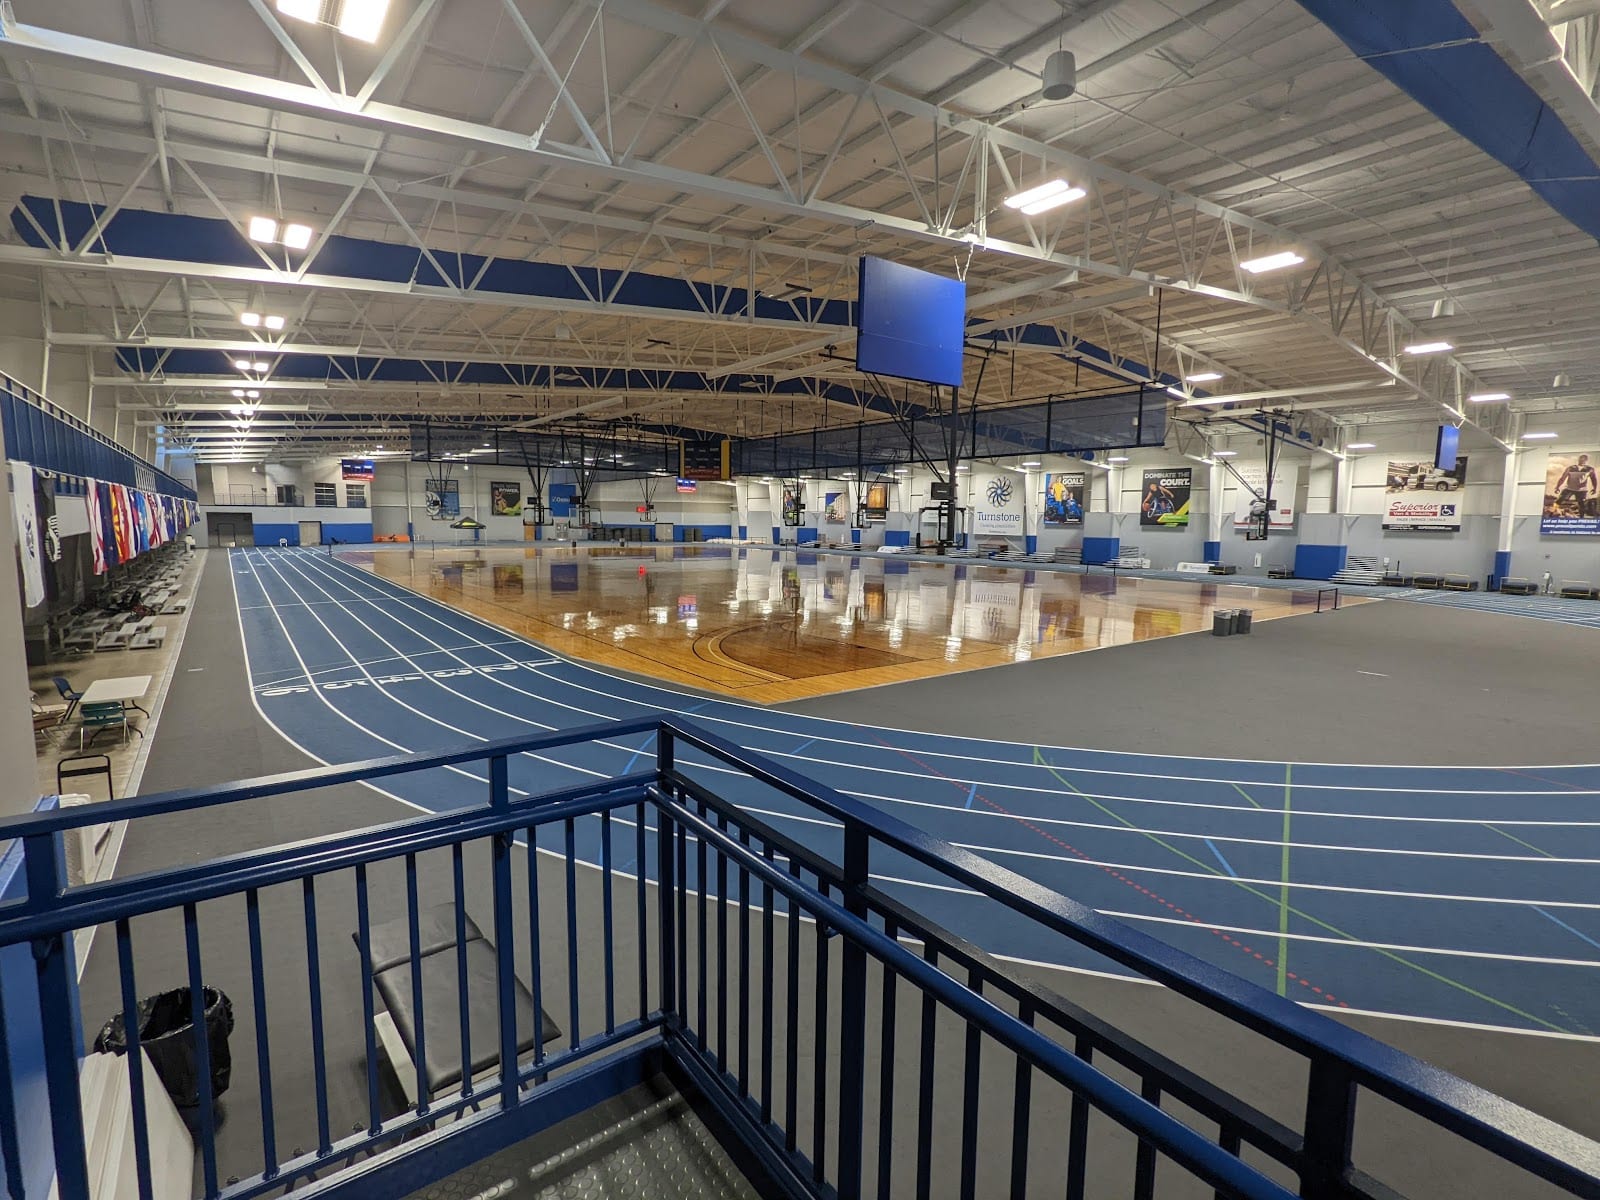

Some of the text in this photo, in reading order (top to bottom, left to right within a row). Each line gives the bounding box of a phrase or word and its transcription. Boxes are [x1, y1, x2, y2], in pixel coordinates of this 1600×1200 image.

[1389, 501, 1440, 512] Superior
[977, 511, 1021, 521] Turnstone
[261, 687, 310, 696] 6
[322, 681, 369, 690] 5
[377, 676, 423, 684] 4
[433, 669, 473, 677] 3
[480, 664, 518, 673] 2
